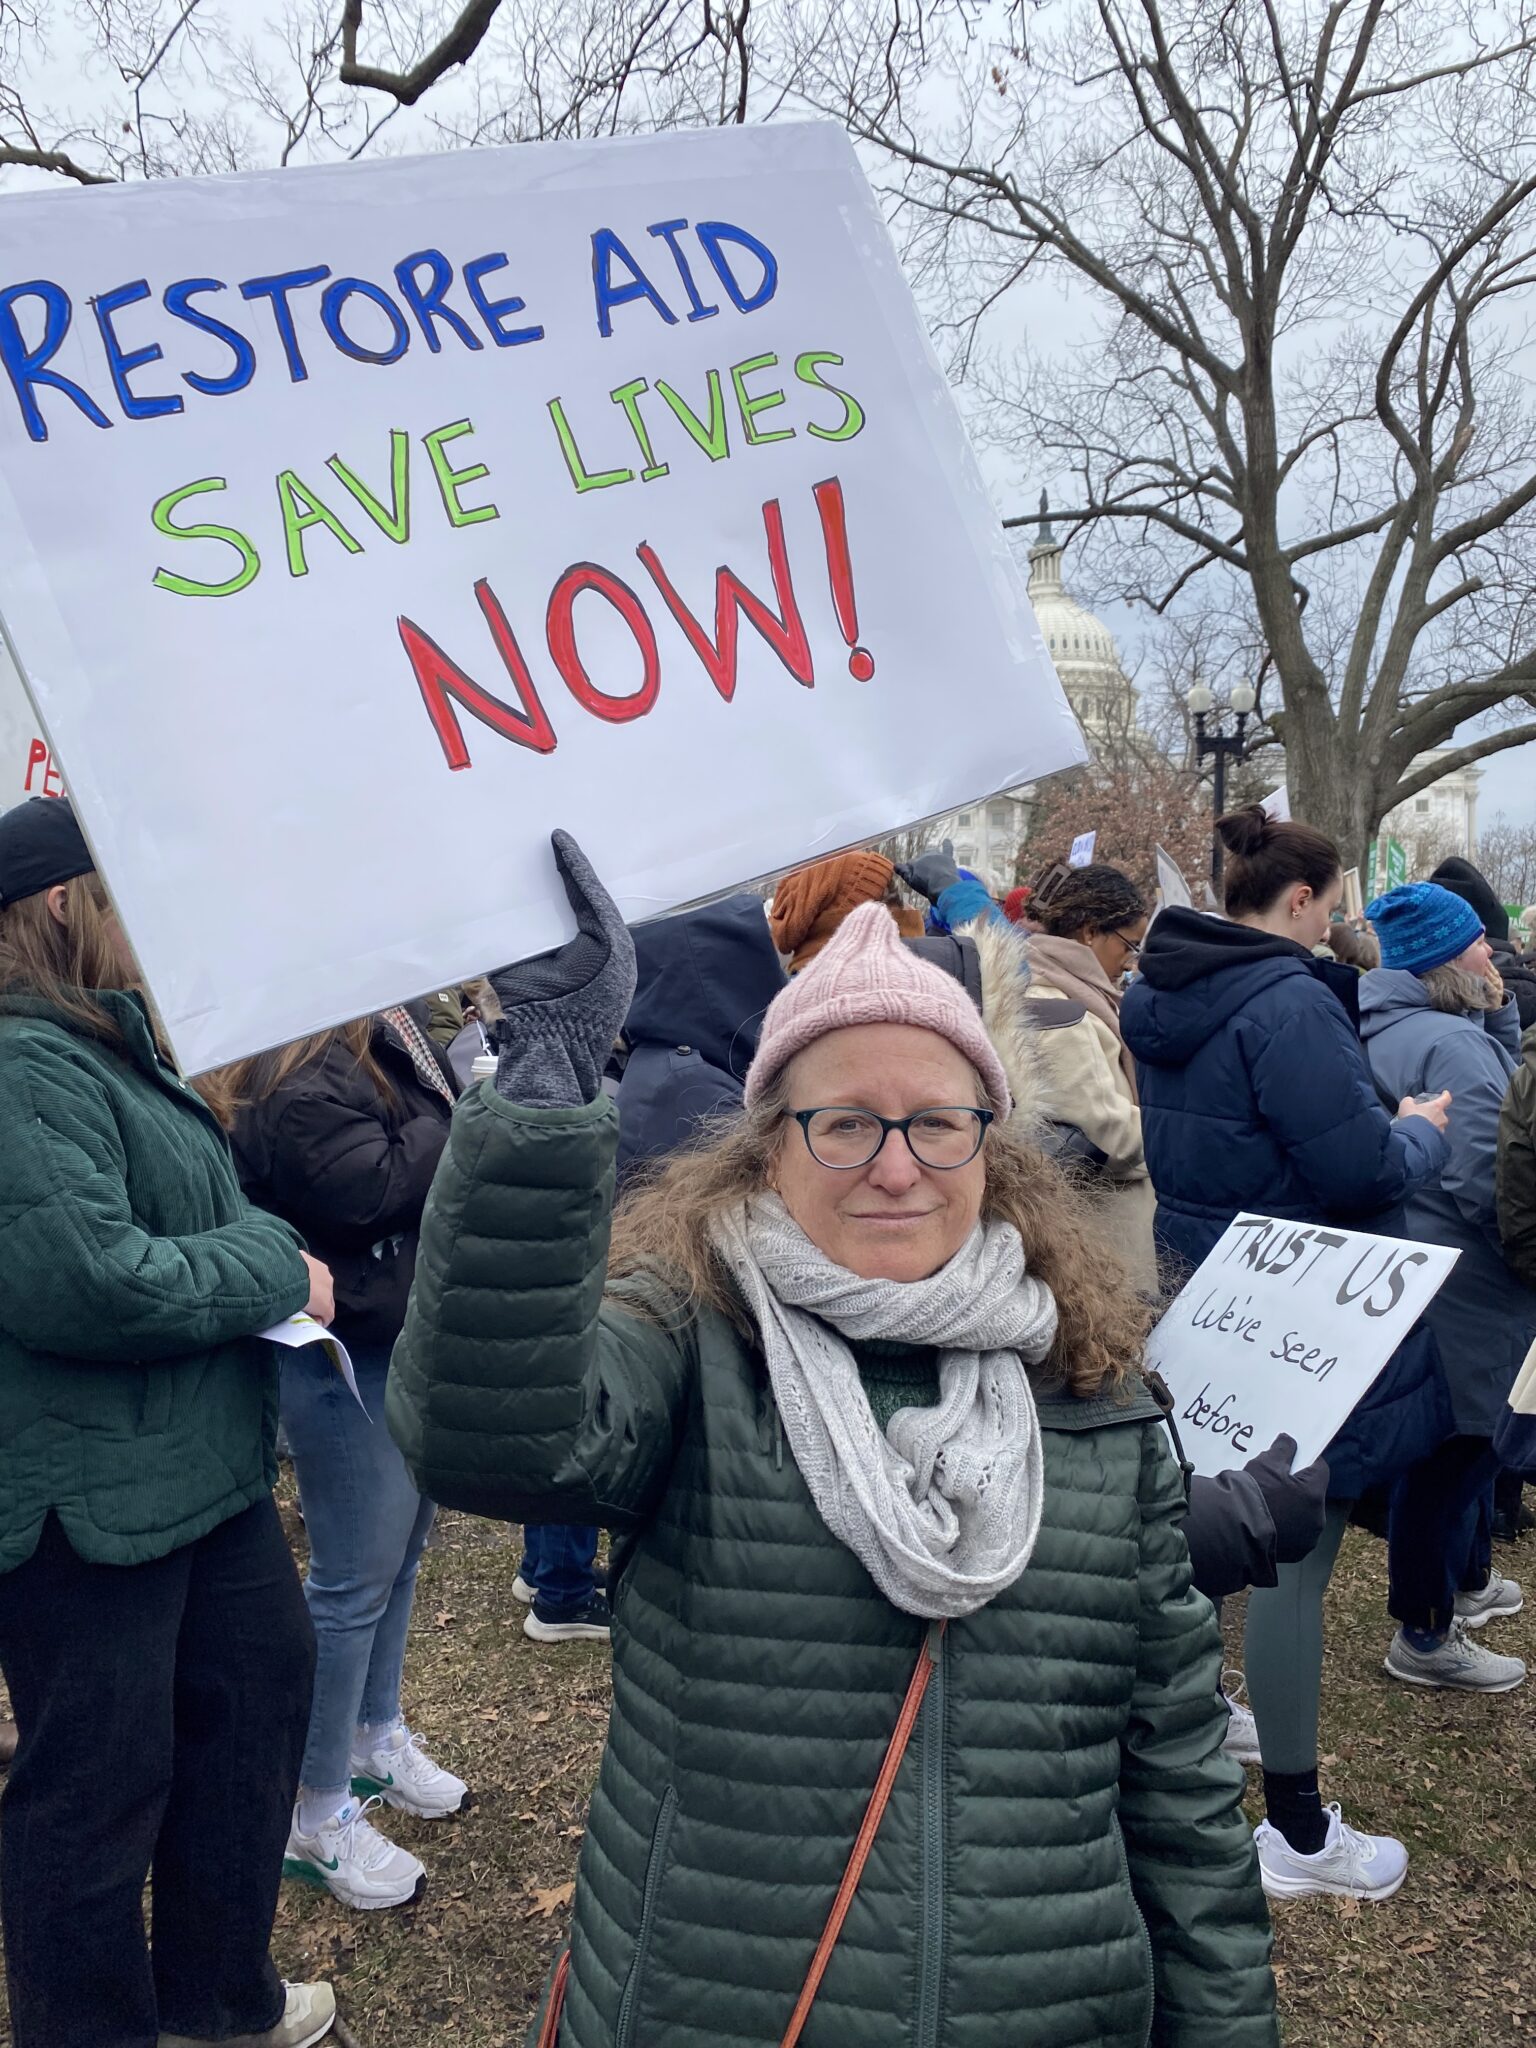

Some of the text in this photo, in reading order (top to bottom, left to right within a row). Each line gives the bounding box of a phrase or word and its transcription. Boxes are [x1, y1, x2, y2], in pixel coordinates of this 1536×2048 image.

[0, 217, 778, 442] RESTORE AID
[152, 351, 865, 597] SAVE LIVES
[398, 476, 875, 770] NOW!
[1191, 1288, 1261, 1342] We've
[1223, 1218, 1428, 1317] TRUST US
[1182, 1383, 1254, 1452] before
